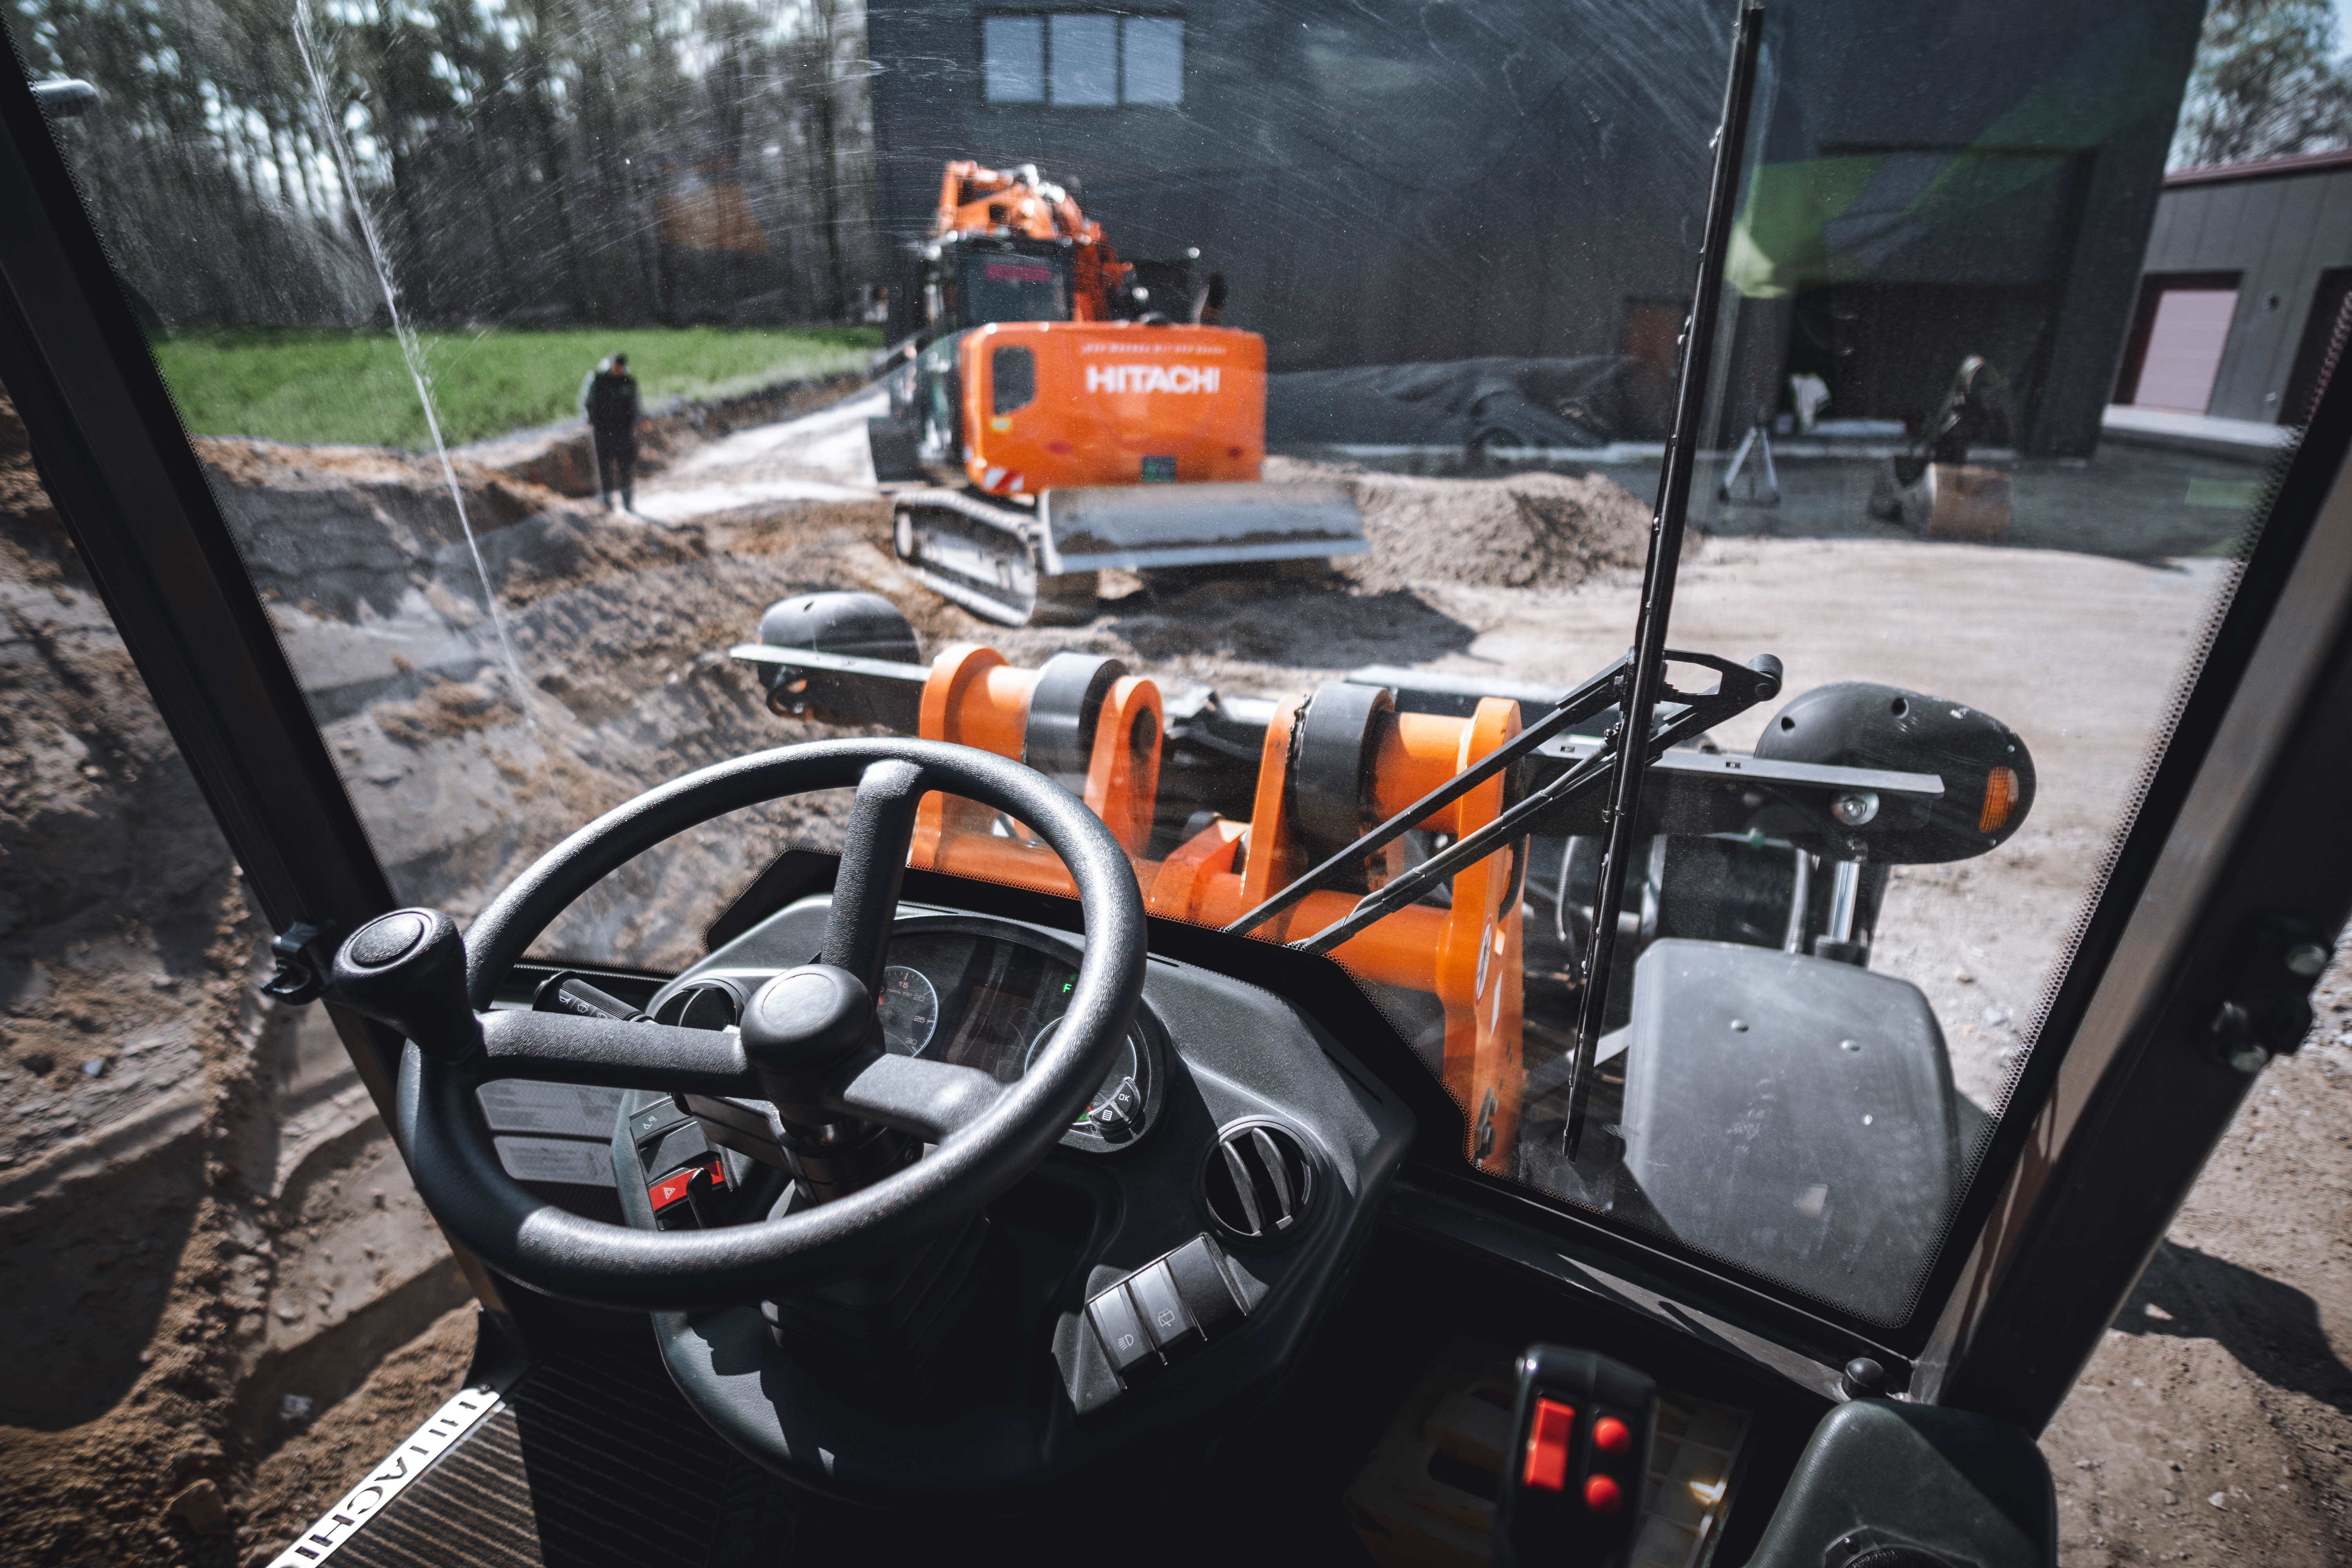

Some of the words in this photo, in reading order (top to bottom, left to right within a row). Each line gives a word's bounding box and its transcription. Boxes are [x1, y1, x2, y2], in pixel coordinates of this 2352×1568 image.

[1086, 363, 1220, 393] HITACHI
[1063, 983, 1072, 993] F
[1119, 1094, 1130, 1102] OK
[295, 1401, 478, 1560] HITACHI
